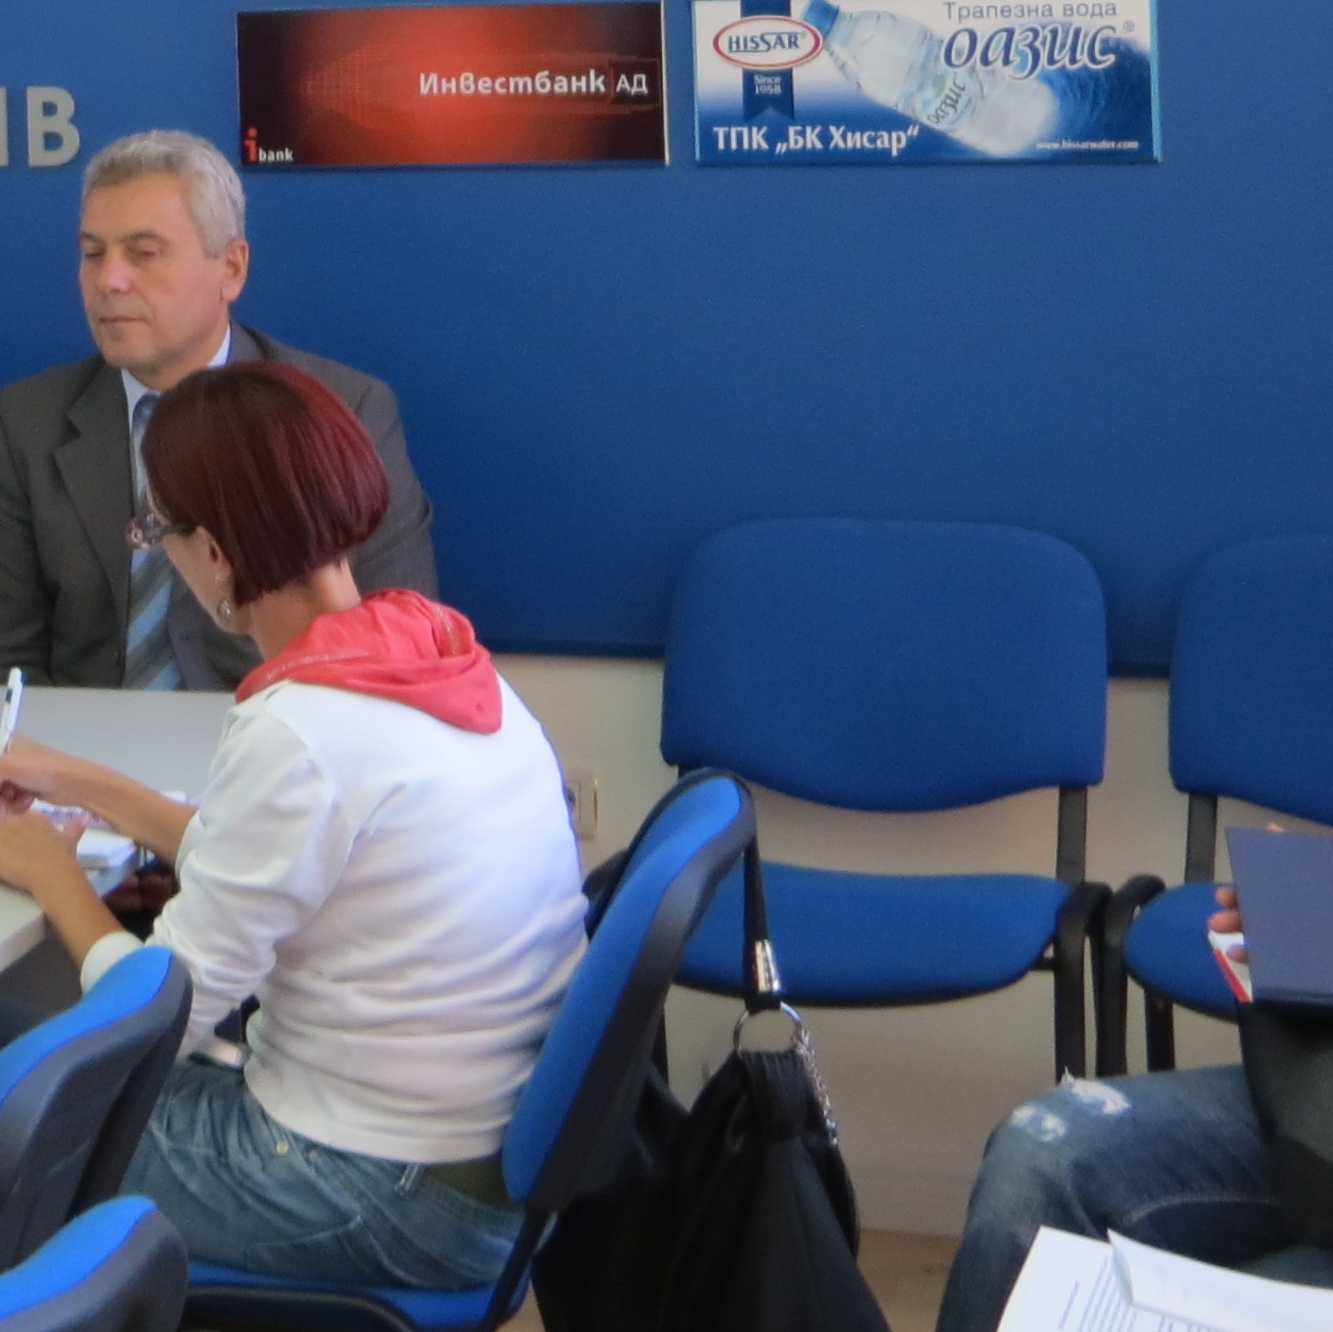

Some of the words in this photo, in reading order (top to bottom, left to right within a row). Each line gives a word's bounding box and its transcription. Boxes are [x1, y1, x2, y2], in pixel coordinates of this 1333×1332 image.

[944, 2, 1054, 22] Трапезна
[1062, 0, 1117, 17] вода
[728, 29, 800, 53] HISSAR
[943, 22, 1117, 80] оазис
[419, 70, 607, 95] Инвестбанк
[616, 74, 648, 93] АД
[713, 127, 768, 151] ТПК
